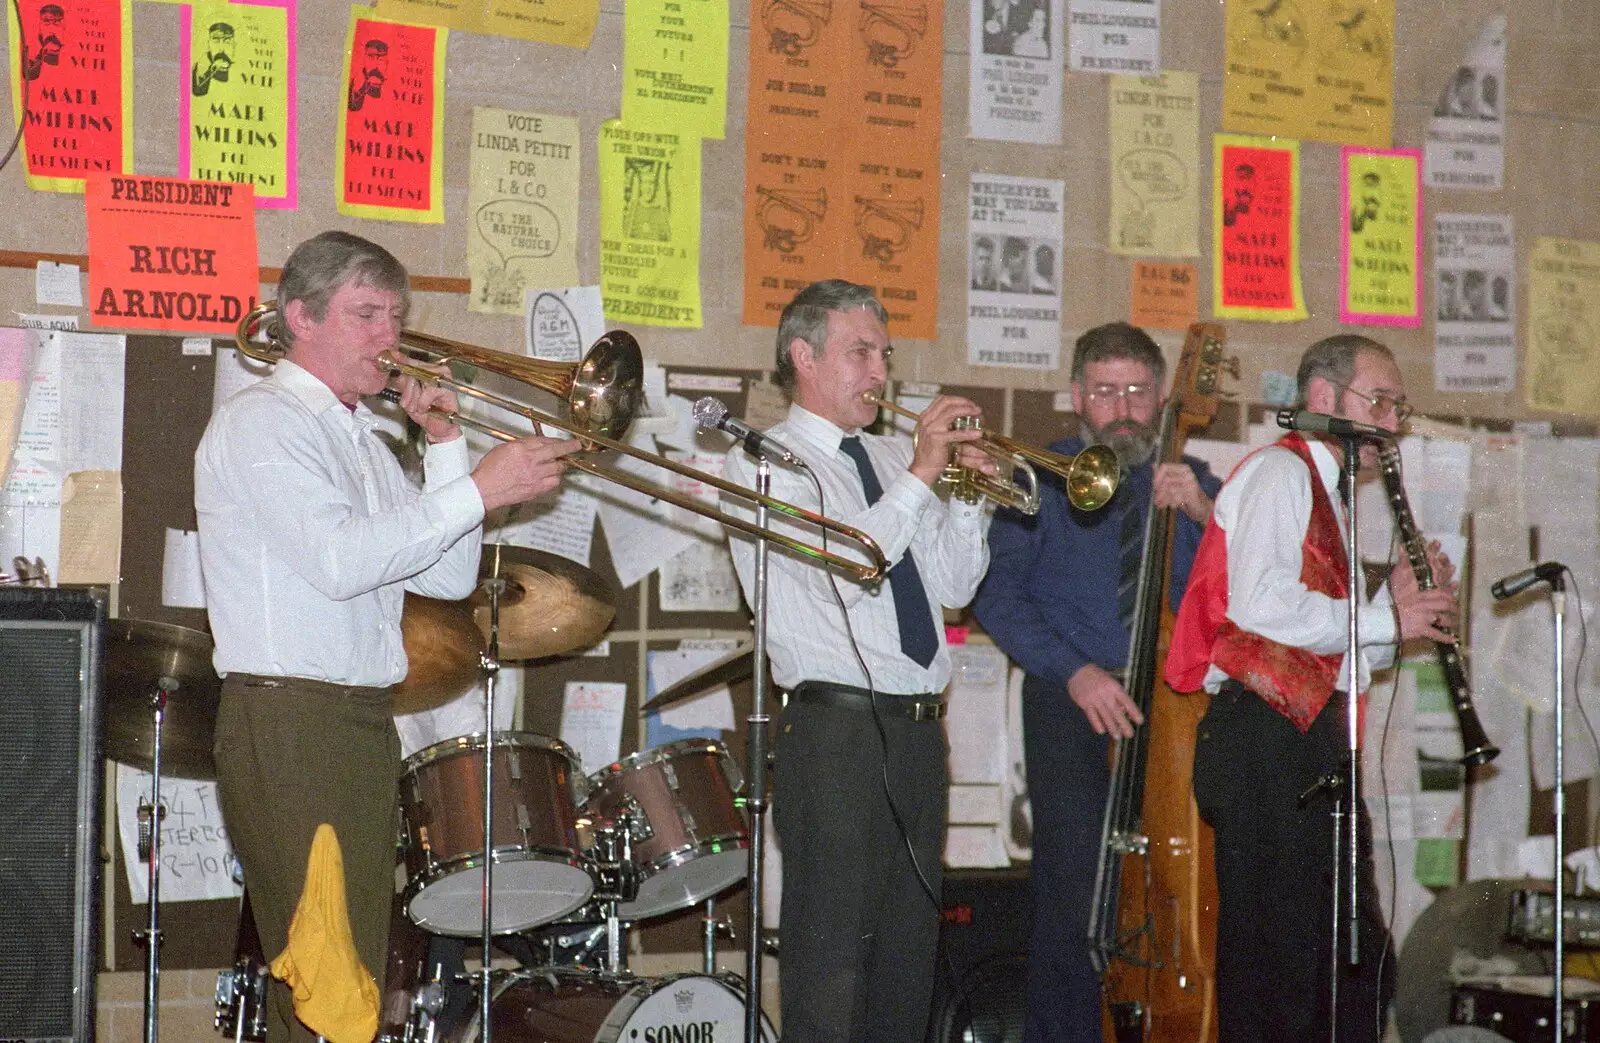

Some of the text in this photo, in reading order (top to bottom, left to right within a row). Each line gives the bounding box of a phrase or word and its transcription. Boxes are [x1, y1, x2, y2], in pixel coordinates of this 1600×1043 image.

[70, 56, 106, 71] VOTE
[249, 60, 273, 71] VOTE
[241, 72, 273, 88] VOTE
[41, 87, 99, 106] MARK
[393, 90, 424, 105] VOTE
[27, 110, 113, 133] WILKINS
[210, 103, 267, 122] MARK
[364, 118, 414, 138] MARK
[508, 114, 543, 133] VOTE
[53, 136, 78, 150] FOR
[196, 125, 278, 149] WILKINS
[478, 132, 573, 160] LINDA PETTIT
[349, 139, 425, 164] WILKINS
[612, 142, 633, 154] THE
[31, 153, 112, 171] PRESIDENT
[221, 152, 247, 165] FOR
[198, 168, 275, 186] PRESIDENT
[372, 165, 396, 180] FOR
[510, 160, 536, 177] FOR
[111, 178, 233, 207] PRESIDENT
[348, 181, 423, 201] PRESIDENT
[482, 211, 533, 225] IT'S THE
[492, 223, 542, 238] NATURAL
[510, 237, 552, 251] CHOICE
[129, 245, 217, 277] RICH
[602, 297, 694, 321] PRESIDENT
[1002, 326, 1029, 340] FOR
[644, 1021, 714, 1043] SONOR
